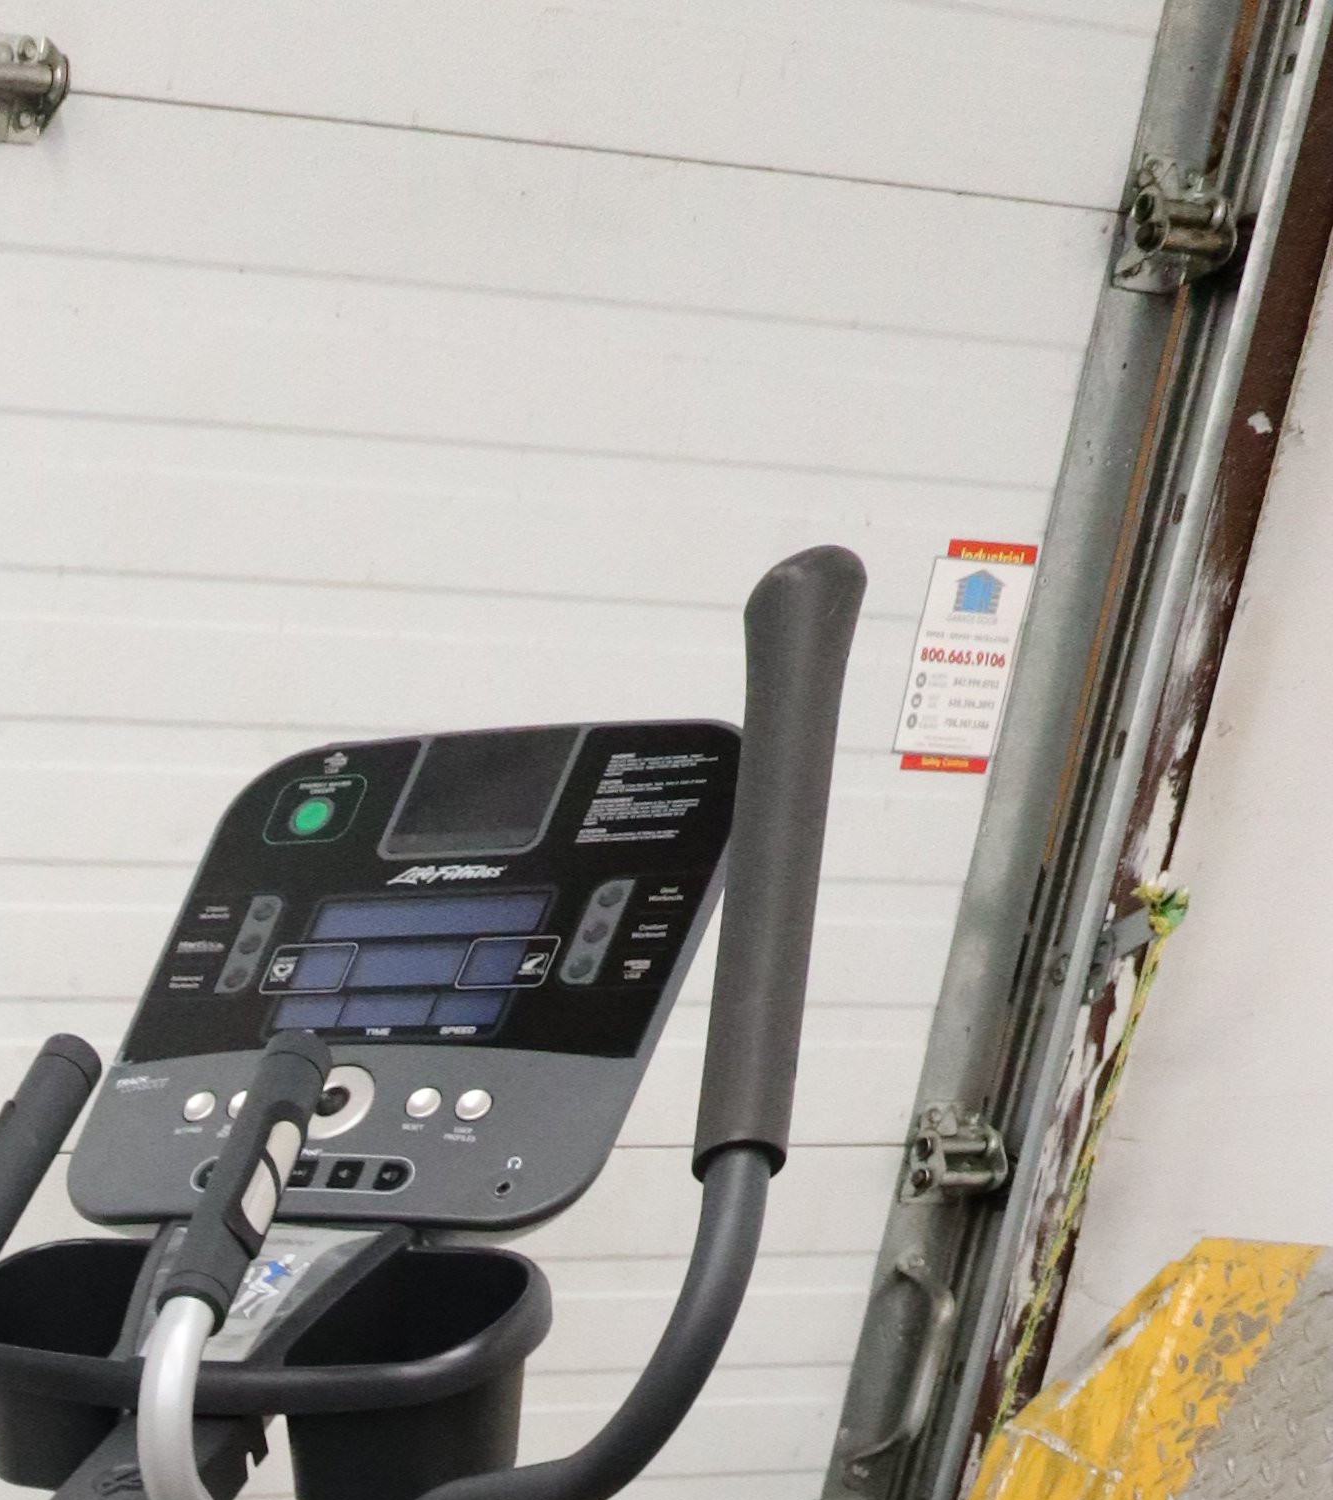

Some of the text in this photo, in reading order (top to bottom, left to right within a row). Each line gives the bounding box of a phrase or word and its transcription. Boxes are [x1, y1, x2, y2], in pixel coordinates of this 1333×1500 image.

[961, 547, 1025, 564] Industrial
[920, 647, 1006, 668] 800.665.9106
[365, 1027, 392, 1037] TIME
[439, 1025, 478, 1036] SPEED
